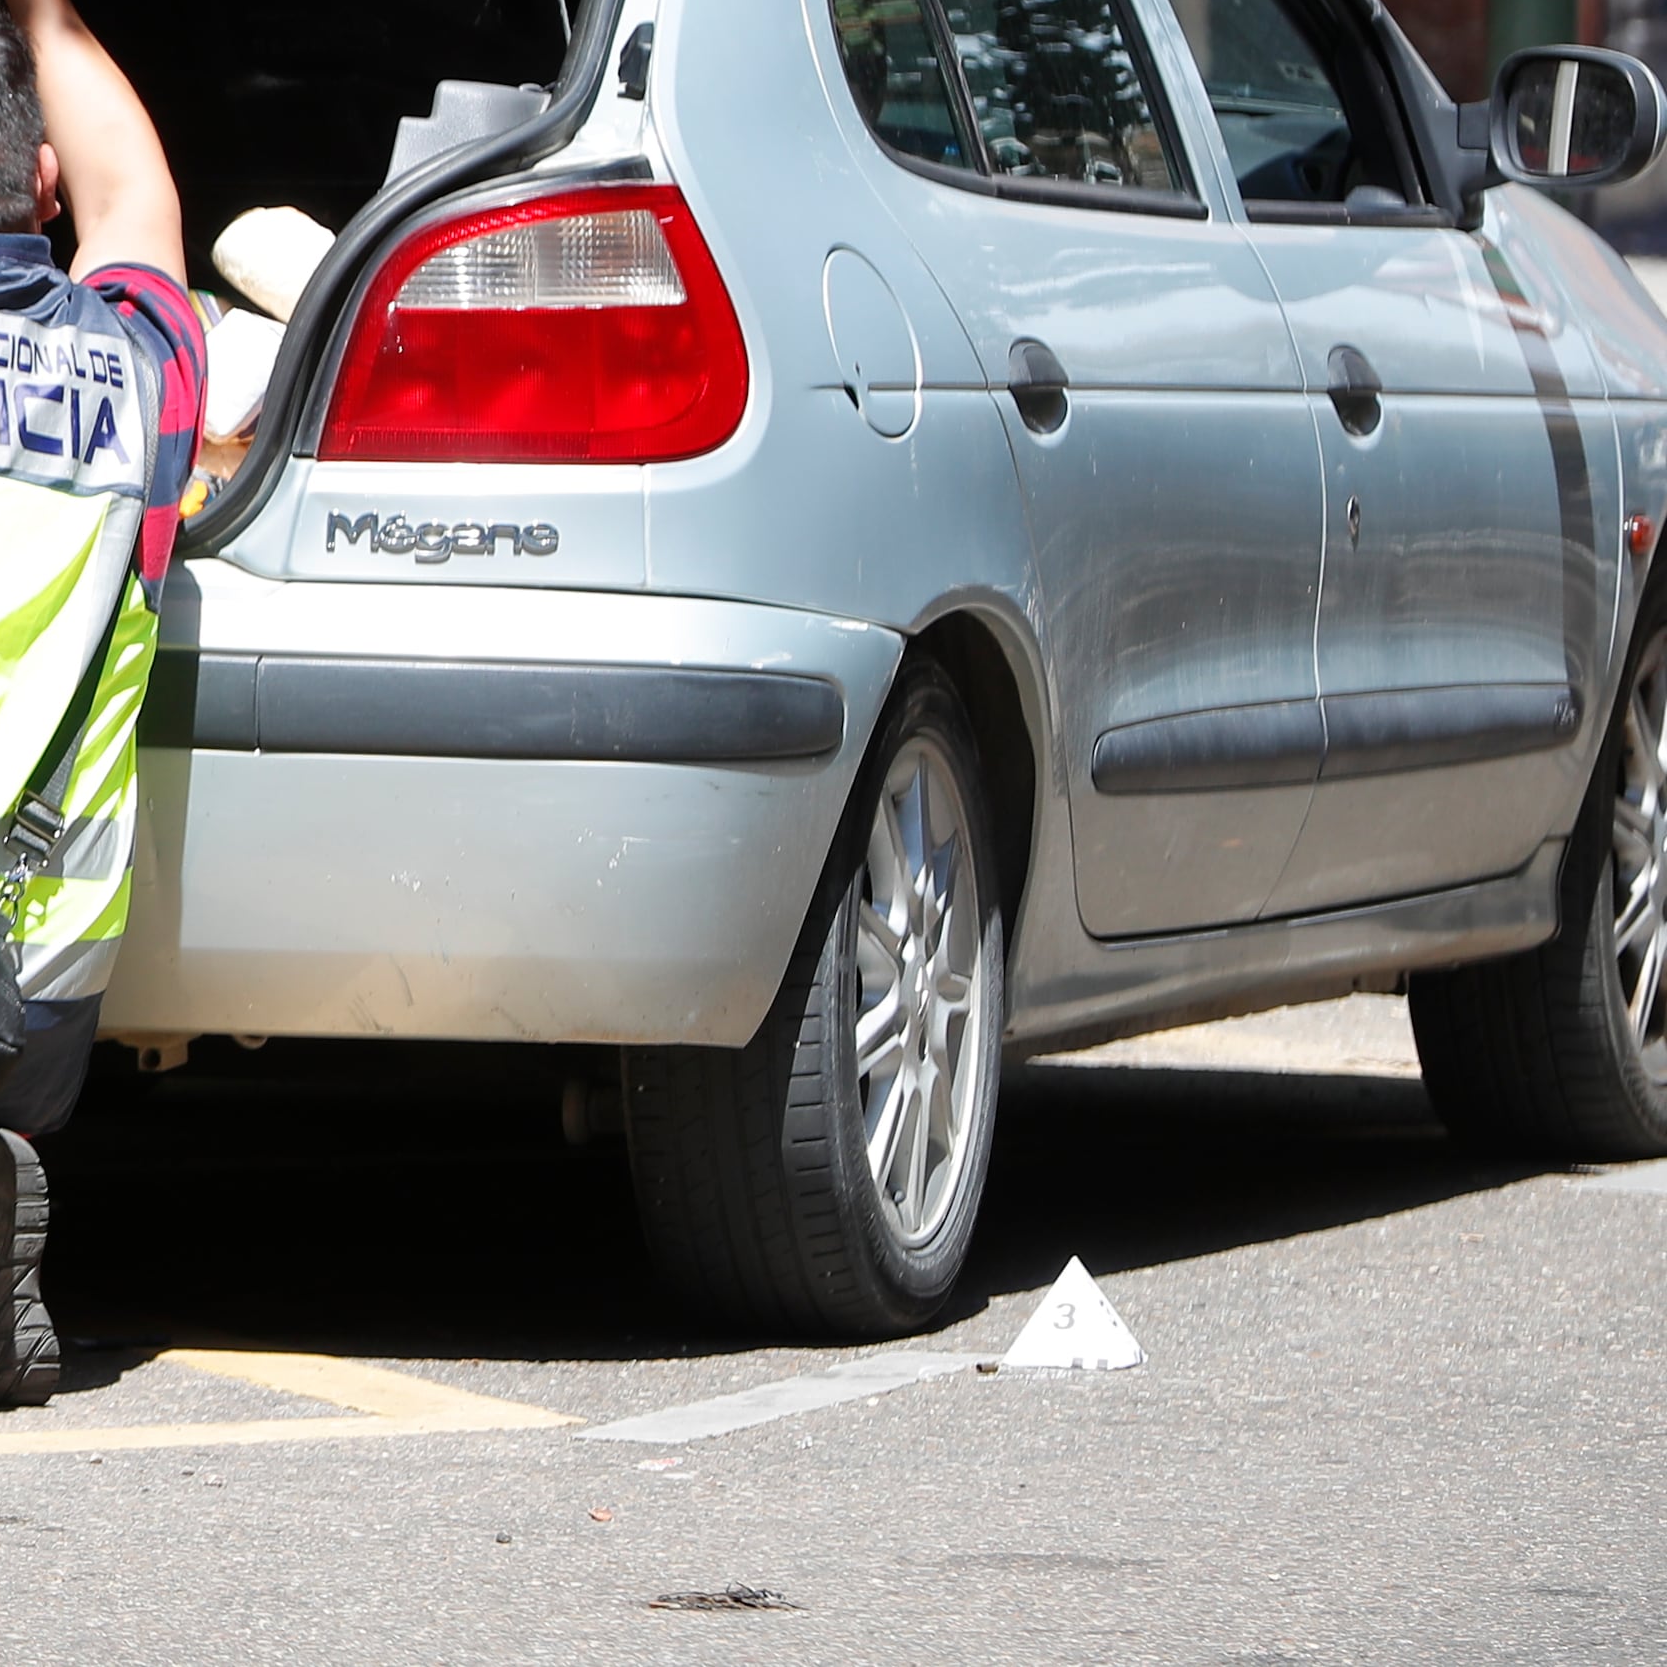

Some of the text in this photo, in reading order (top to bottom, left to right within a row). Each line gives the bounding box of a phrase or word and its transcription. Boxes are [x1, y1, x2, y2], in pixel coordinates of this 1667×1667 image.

[87, 348, 124, 389] DE
[325, 507, 560, 565] Mégane
[1053, 1303, 1076, 1330] 3
